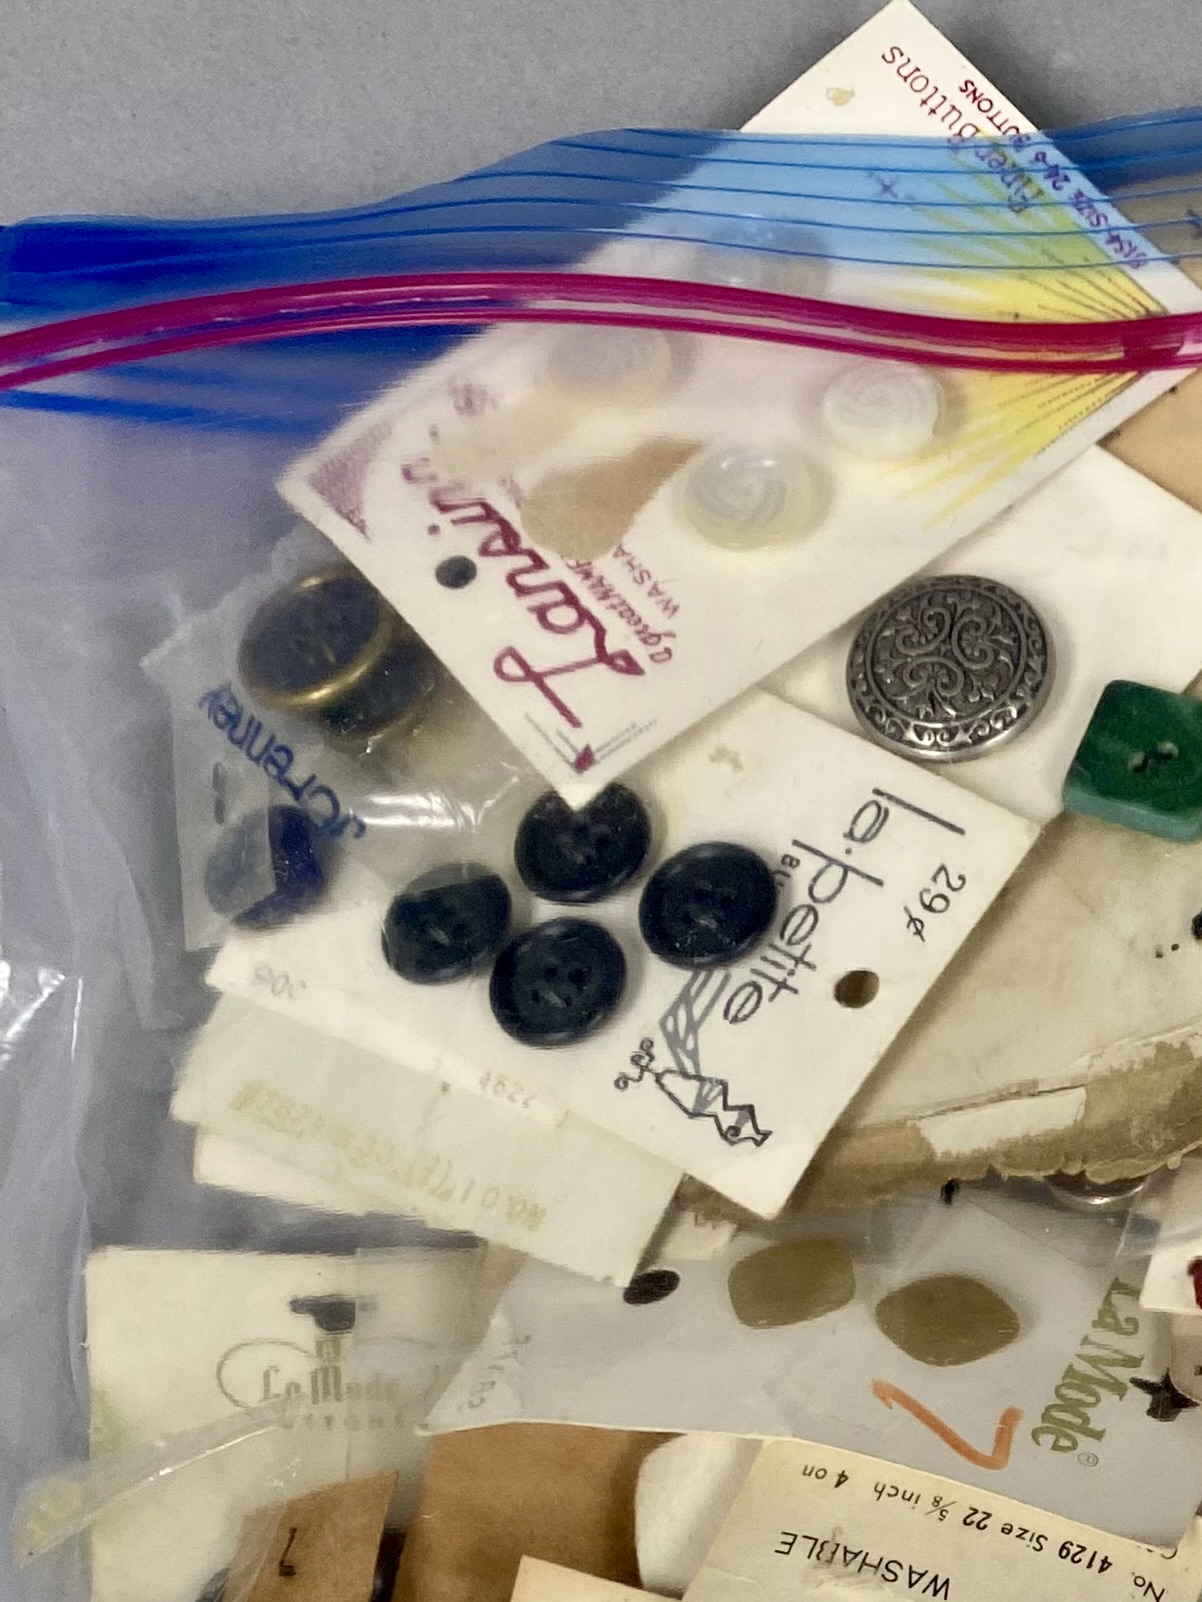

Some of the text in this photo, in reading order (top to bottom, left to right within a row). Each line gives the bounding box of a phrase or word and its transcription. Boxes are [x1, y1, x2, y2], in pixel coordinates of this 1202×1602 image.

[883, 43, 981, 152] Buttons
[904, 863, 967, 943] 29¢
[803, 1465, 826, 1481] on
[874, 1482, 921, 1509] inch
[962, 1508, 992, 1529] 22
[1002, 1523, 1046, 1550] Size
[776, 1533, 950, 1599] WASHABLE
[1059, 1542, 1111, 1573] 4129
[1130, 1573, 1166, 1602] No.
